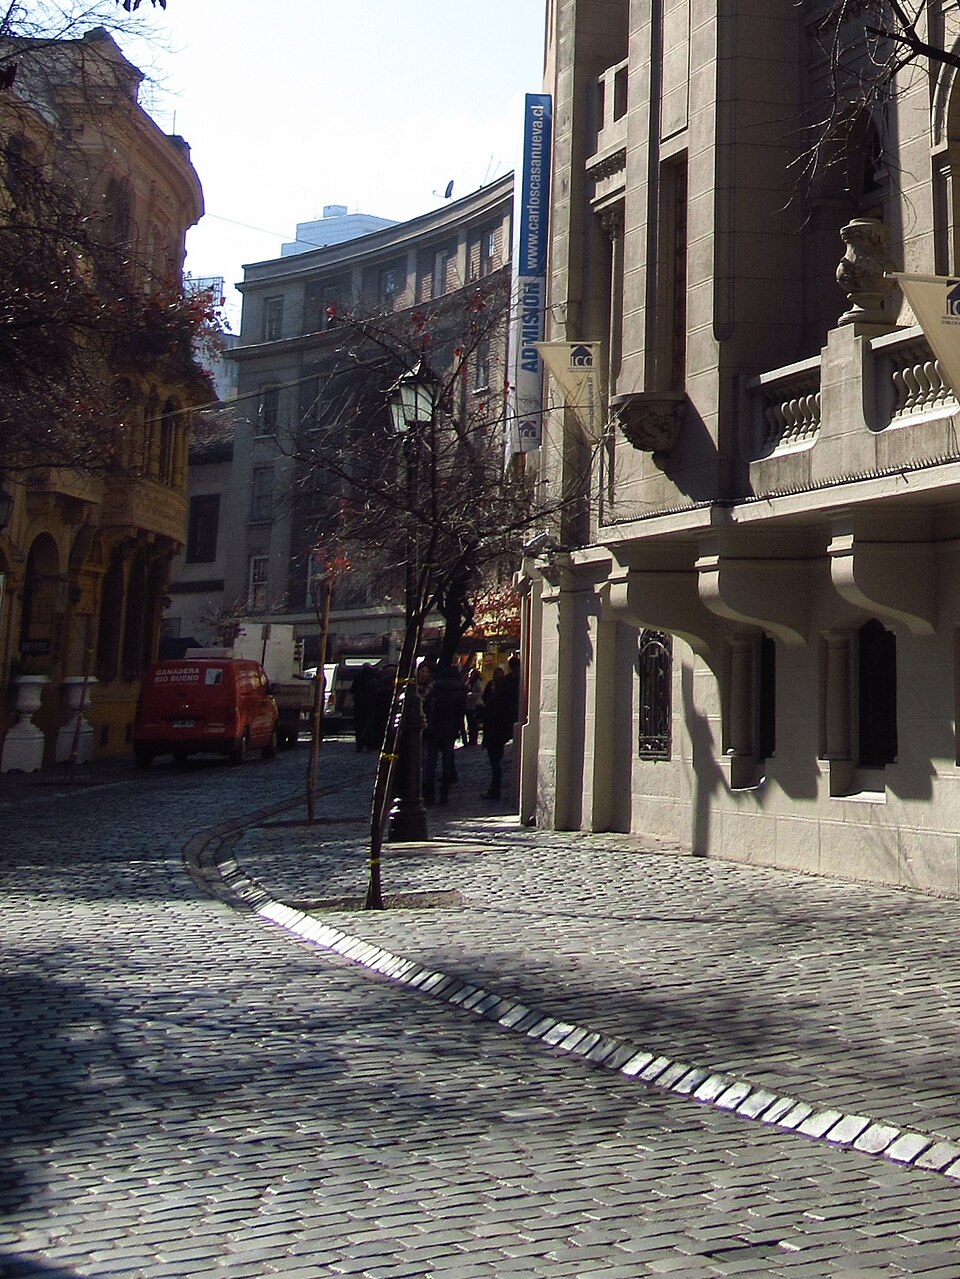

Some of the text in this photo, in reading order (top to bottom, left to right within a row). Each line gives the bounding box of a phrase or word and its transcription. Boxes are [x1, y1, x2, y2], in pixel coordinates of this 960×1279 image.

[527, 105, 544, 269] www.carloscasanueva.cl
[571, 356, 592, 368] ICC
[154, 675, 169, 683] RIO
